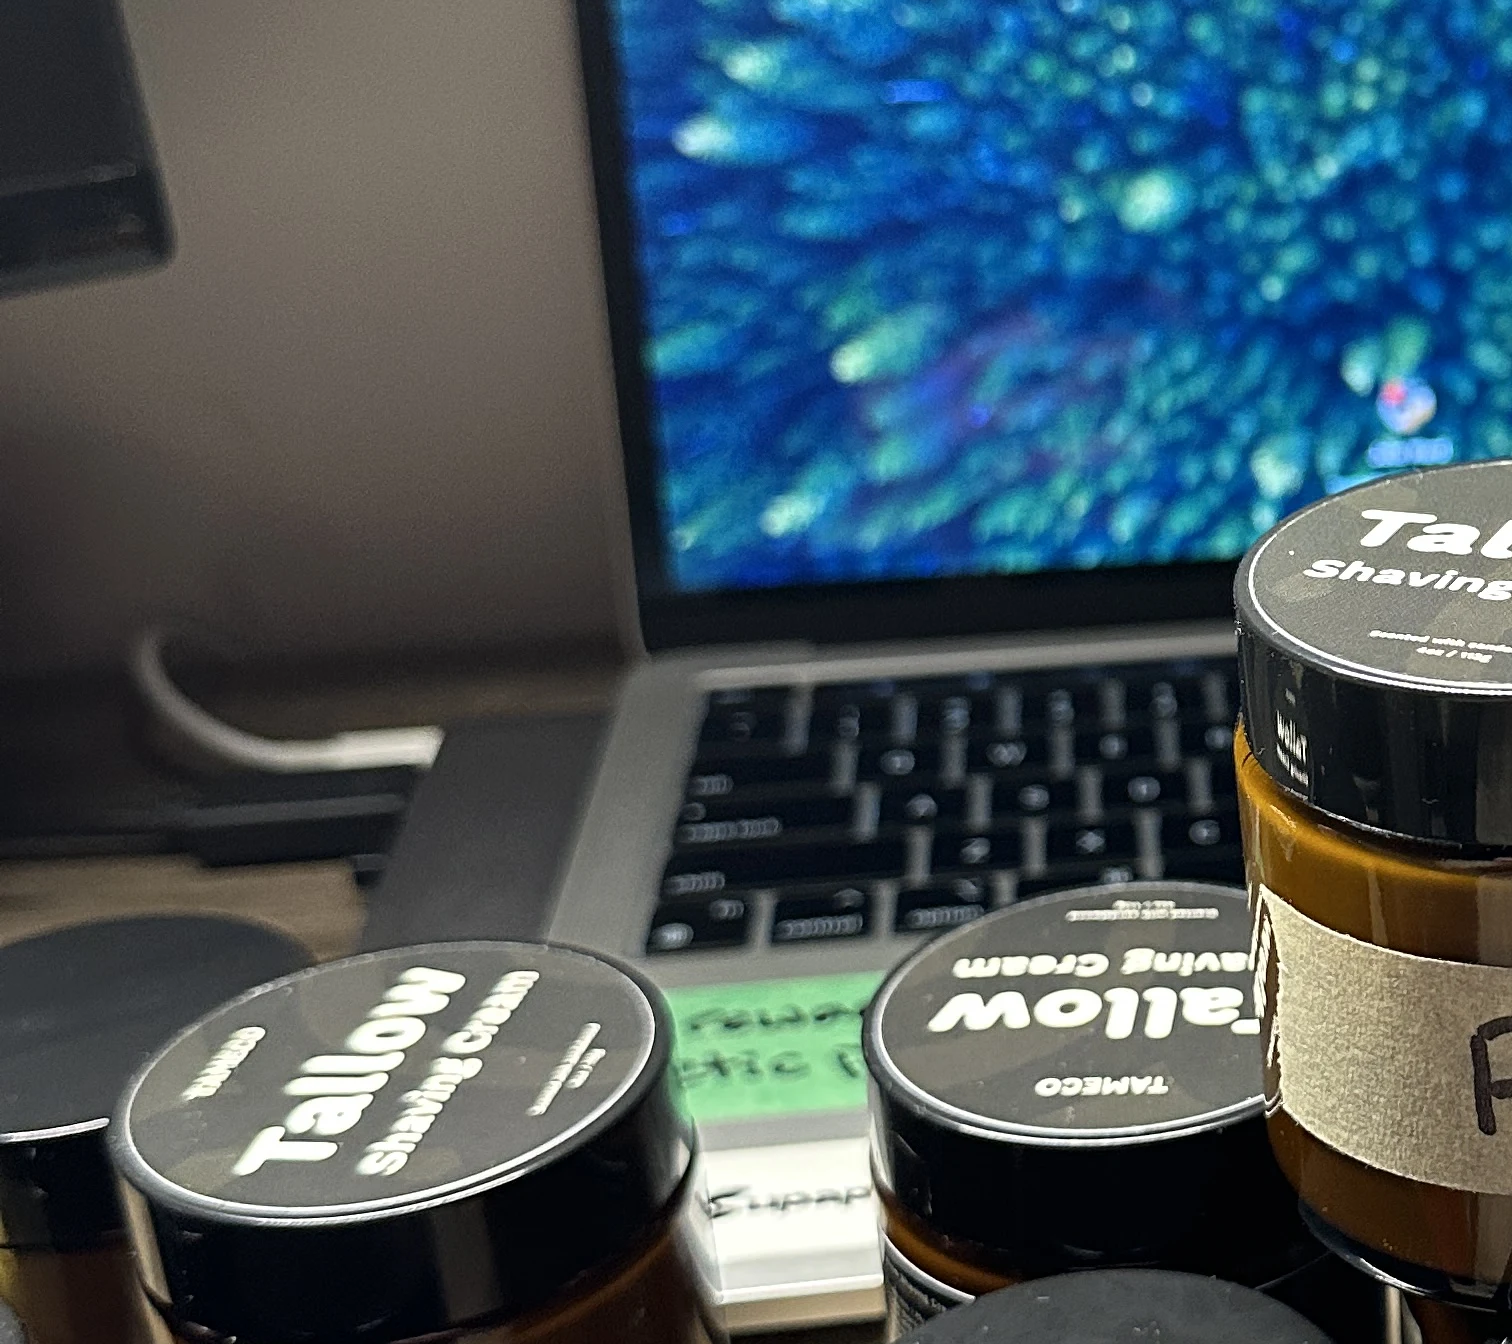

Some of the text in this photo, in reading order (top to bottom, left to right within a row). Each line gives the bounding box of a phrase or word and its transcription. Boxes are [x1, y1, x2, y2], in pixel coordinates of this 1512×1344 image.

[952, 947, 1258, 979] aving Cream
[232, 967, 466, 1176] Tallow
[355, 970, 540, 1175] Shaving Cream
[1035, 1075, 1168, 1097] TAMECO
